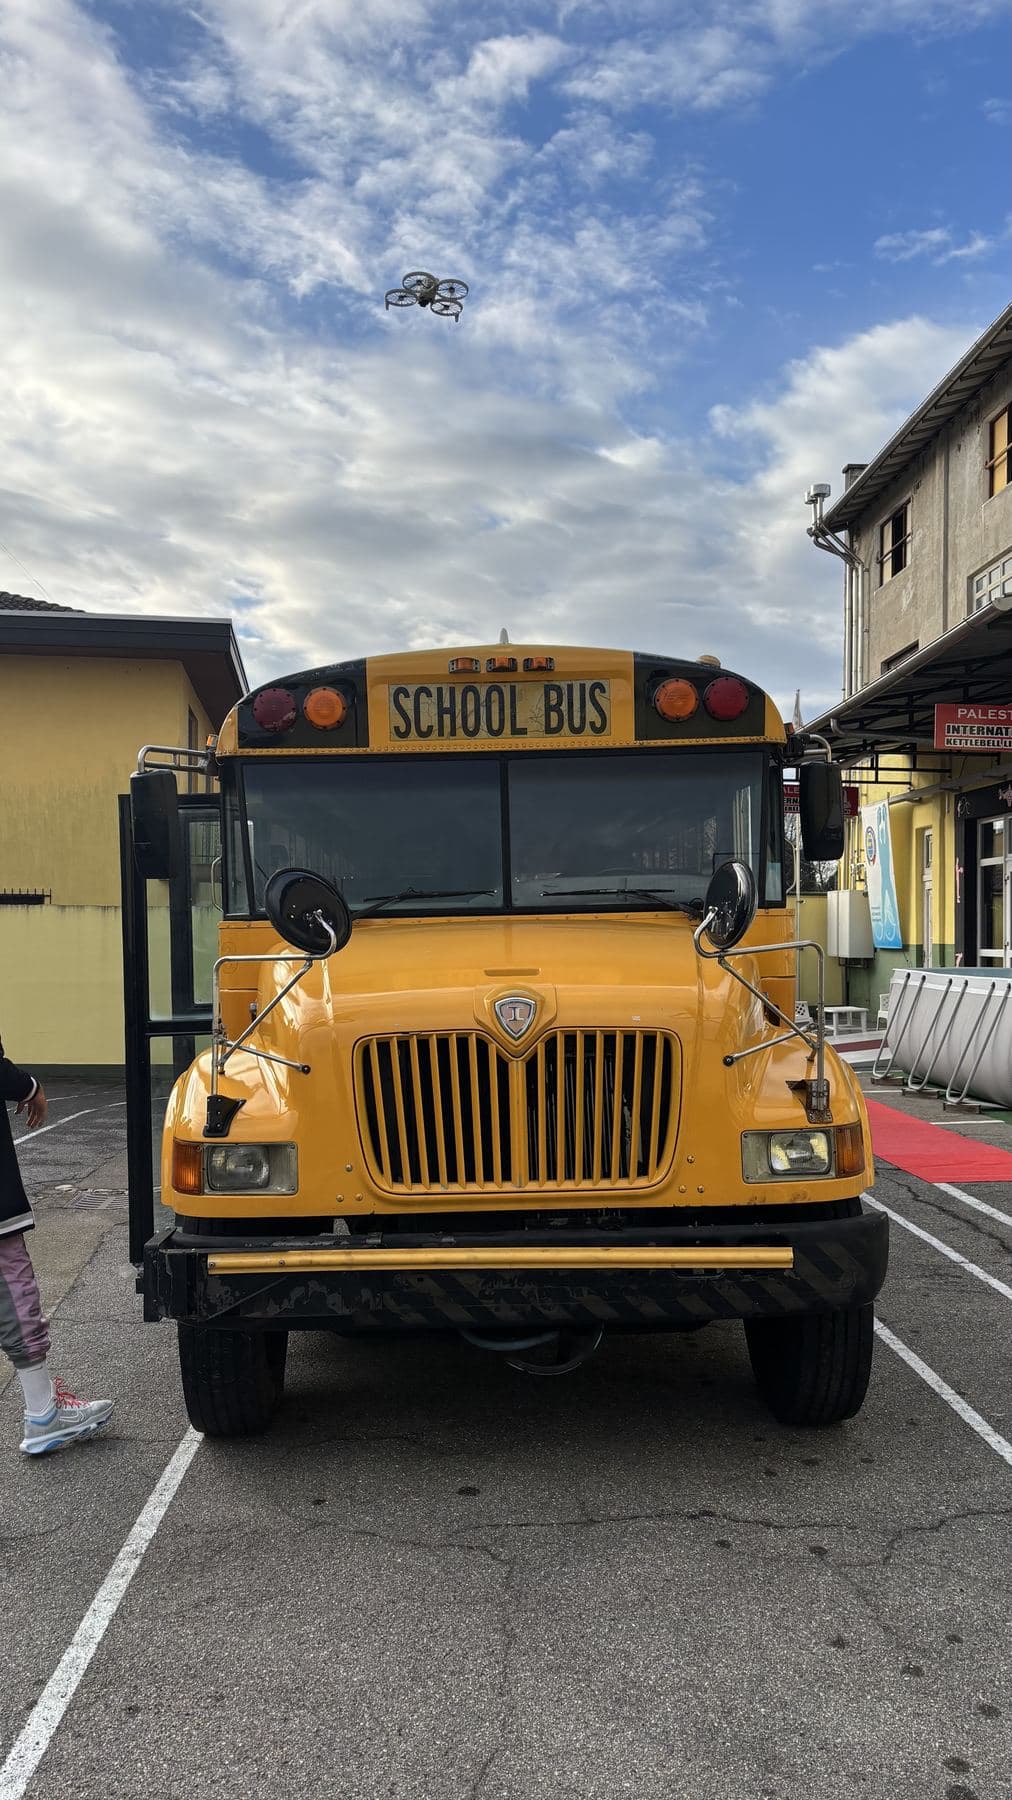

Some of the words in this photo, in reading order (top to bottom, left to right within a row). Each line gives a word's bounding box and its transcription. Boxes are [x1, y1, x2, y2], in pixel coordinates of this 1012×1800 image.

[393, 684, 528, 738] SCHOOL
[543, 682, 607, 735] BUS
[945, 737, 1002, 747] KETTLEBELL
